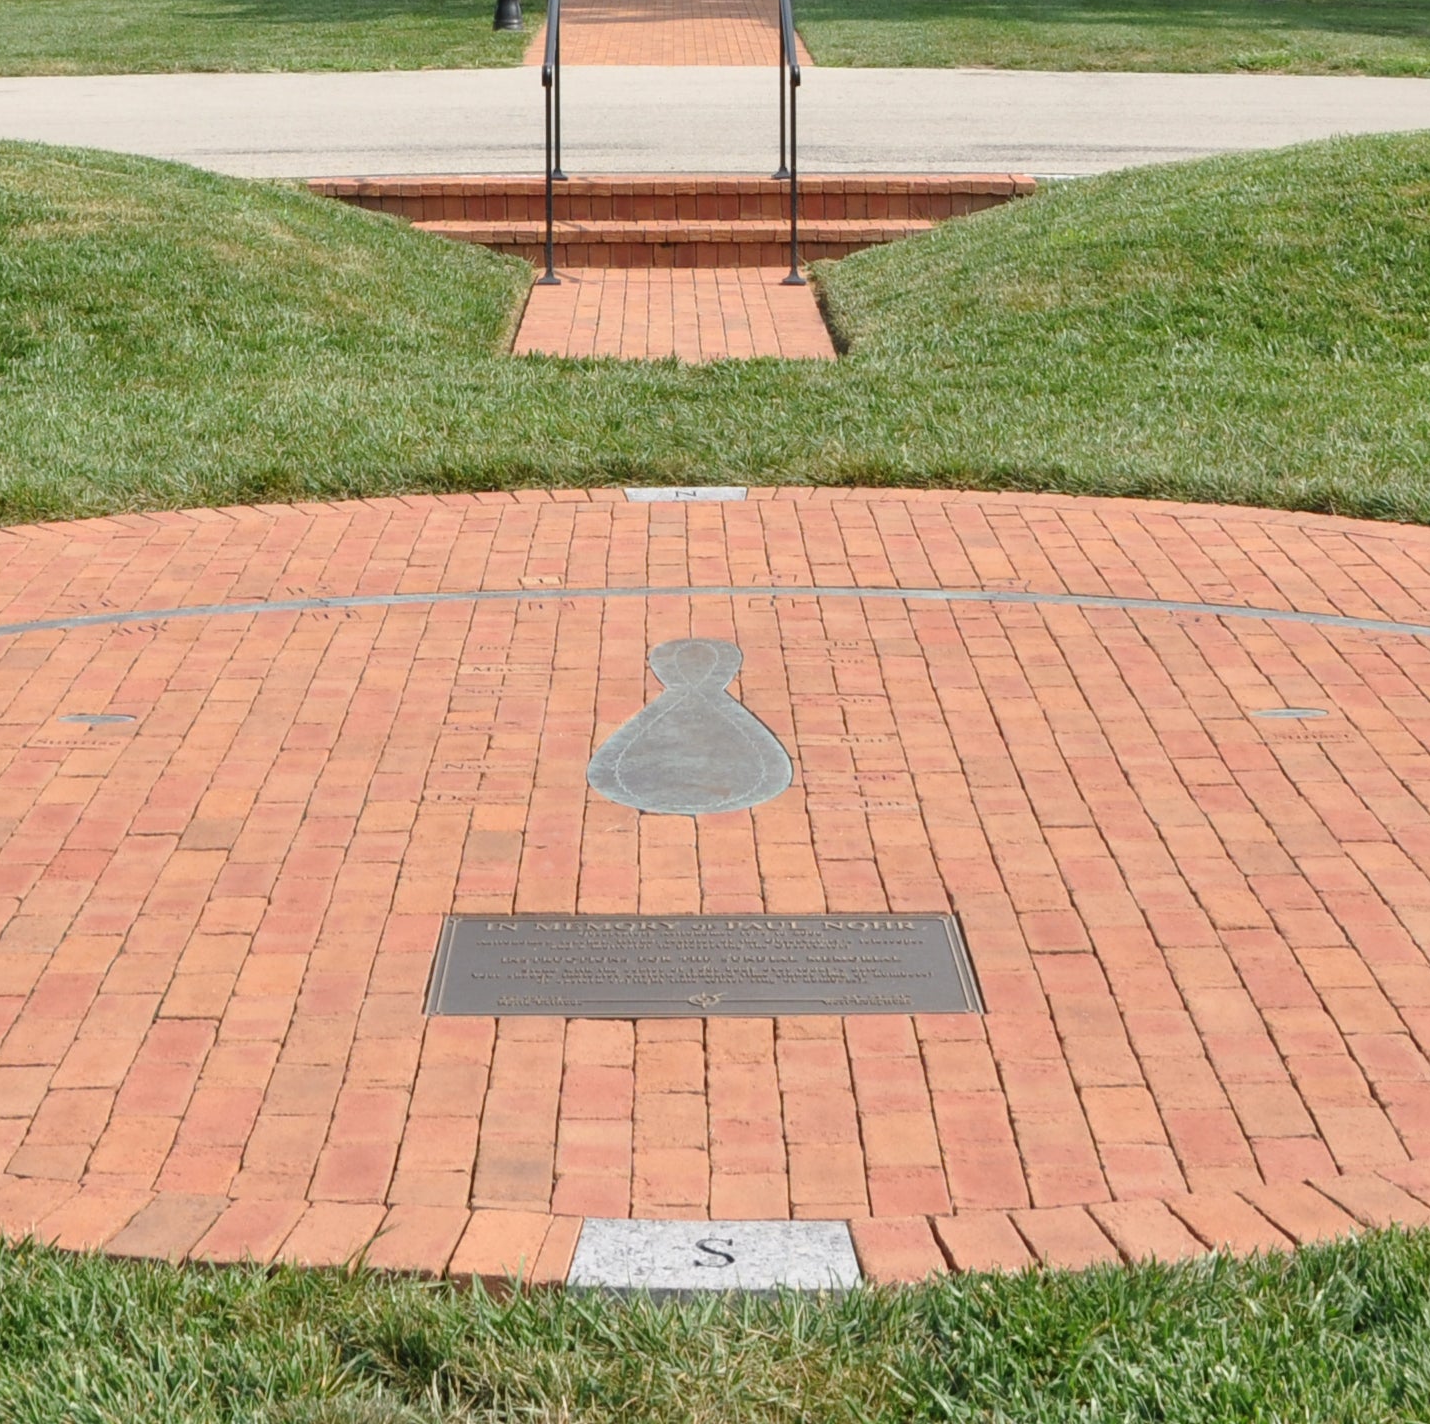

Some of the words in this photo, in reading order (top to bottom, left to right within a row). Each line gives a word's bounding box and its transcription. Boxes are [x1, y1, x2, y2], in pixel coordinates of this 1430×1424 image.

[485, 922, 518, 932] IN
[534, 921, 679, 932] MEMORY
[724, 921, 807, 932] PAUL
[822, 921, 917, 932] NOHR
[500, 956, 629, 965] INSTRUCTIONS
[638, 956, 671, 964] FOR
[681, 955, 711, 964] THE
[721, 955, 798, 964] SUNDIAL
[806, 955, 902, 964] MEMORIAL
[694, 1237, 736, 1268] S
